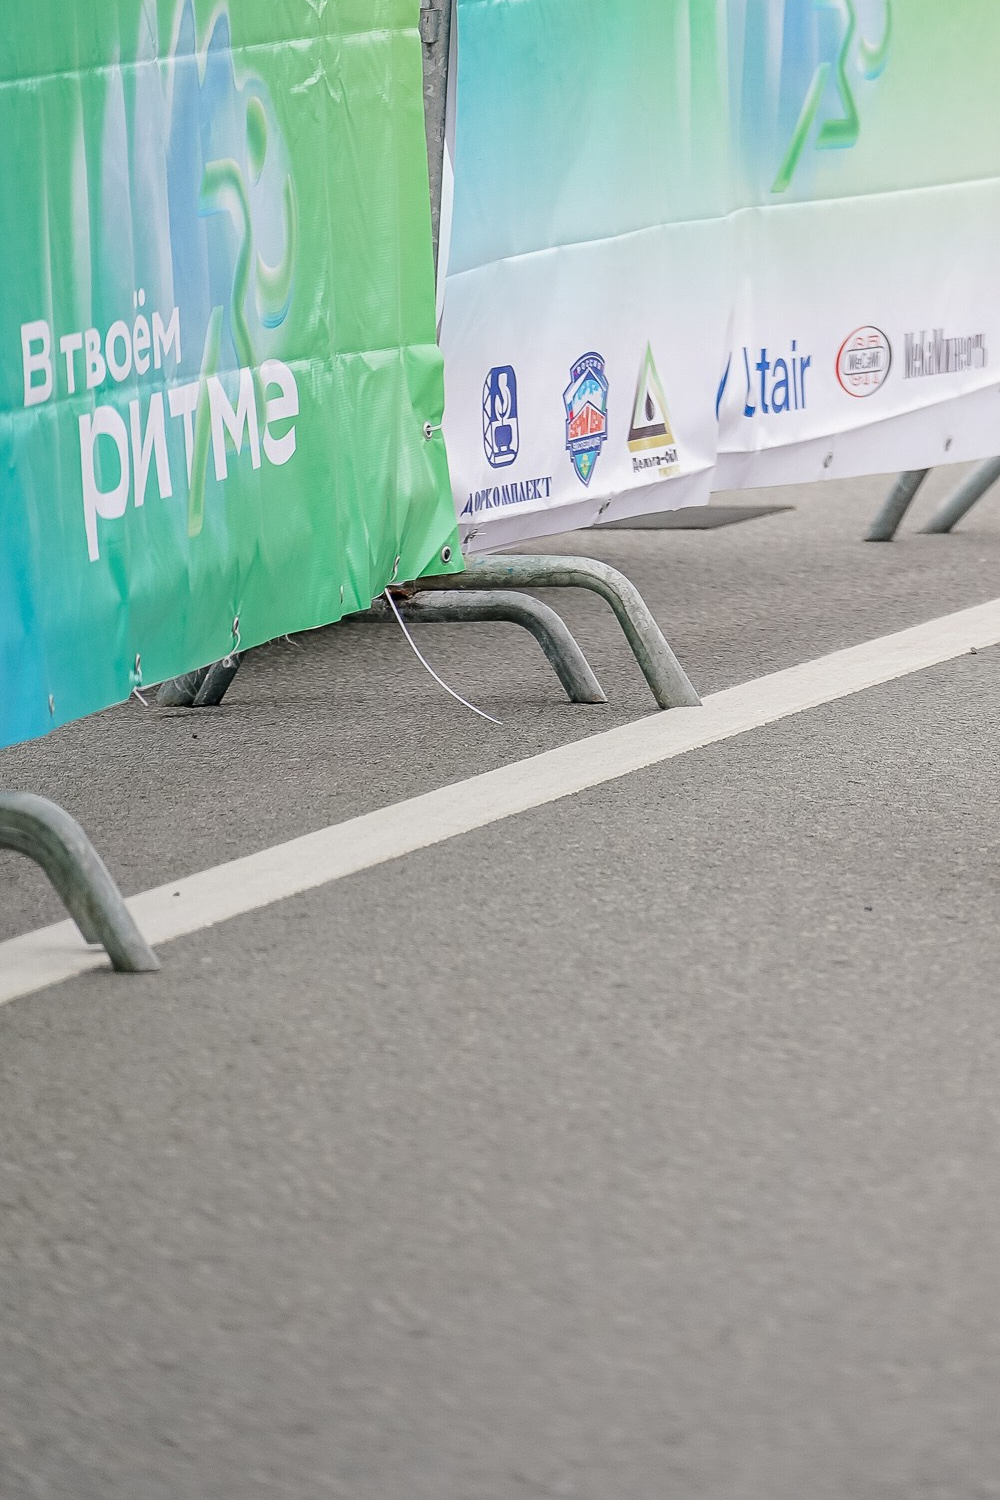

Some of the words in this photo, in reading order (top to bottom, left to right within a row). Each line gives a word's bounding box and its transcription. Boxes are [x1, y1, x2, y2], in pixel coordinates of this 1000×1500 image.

[21, 320, 53, 408] В
[60, 288, 182, 394] твоём
[78, 358, 299, 563] ритме
[460, 476, 552, 517] ДОРКОМПЛЕКТ
